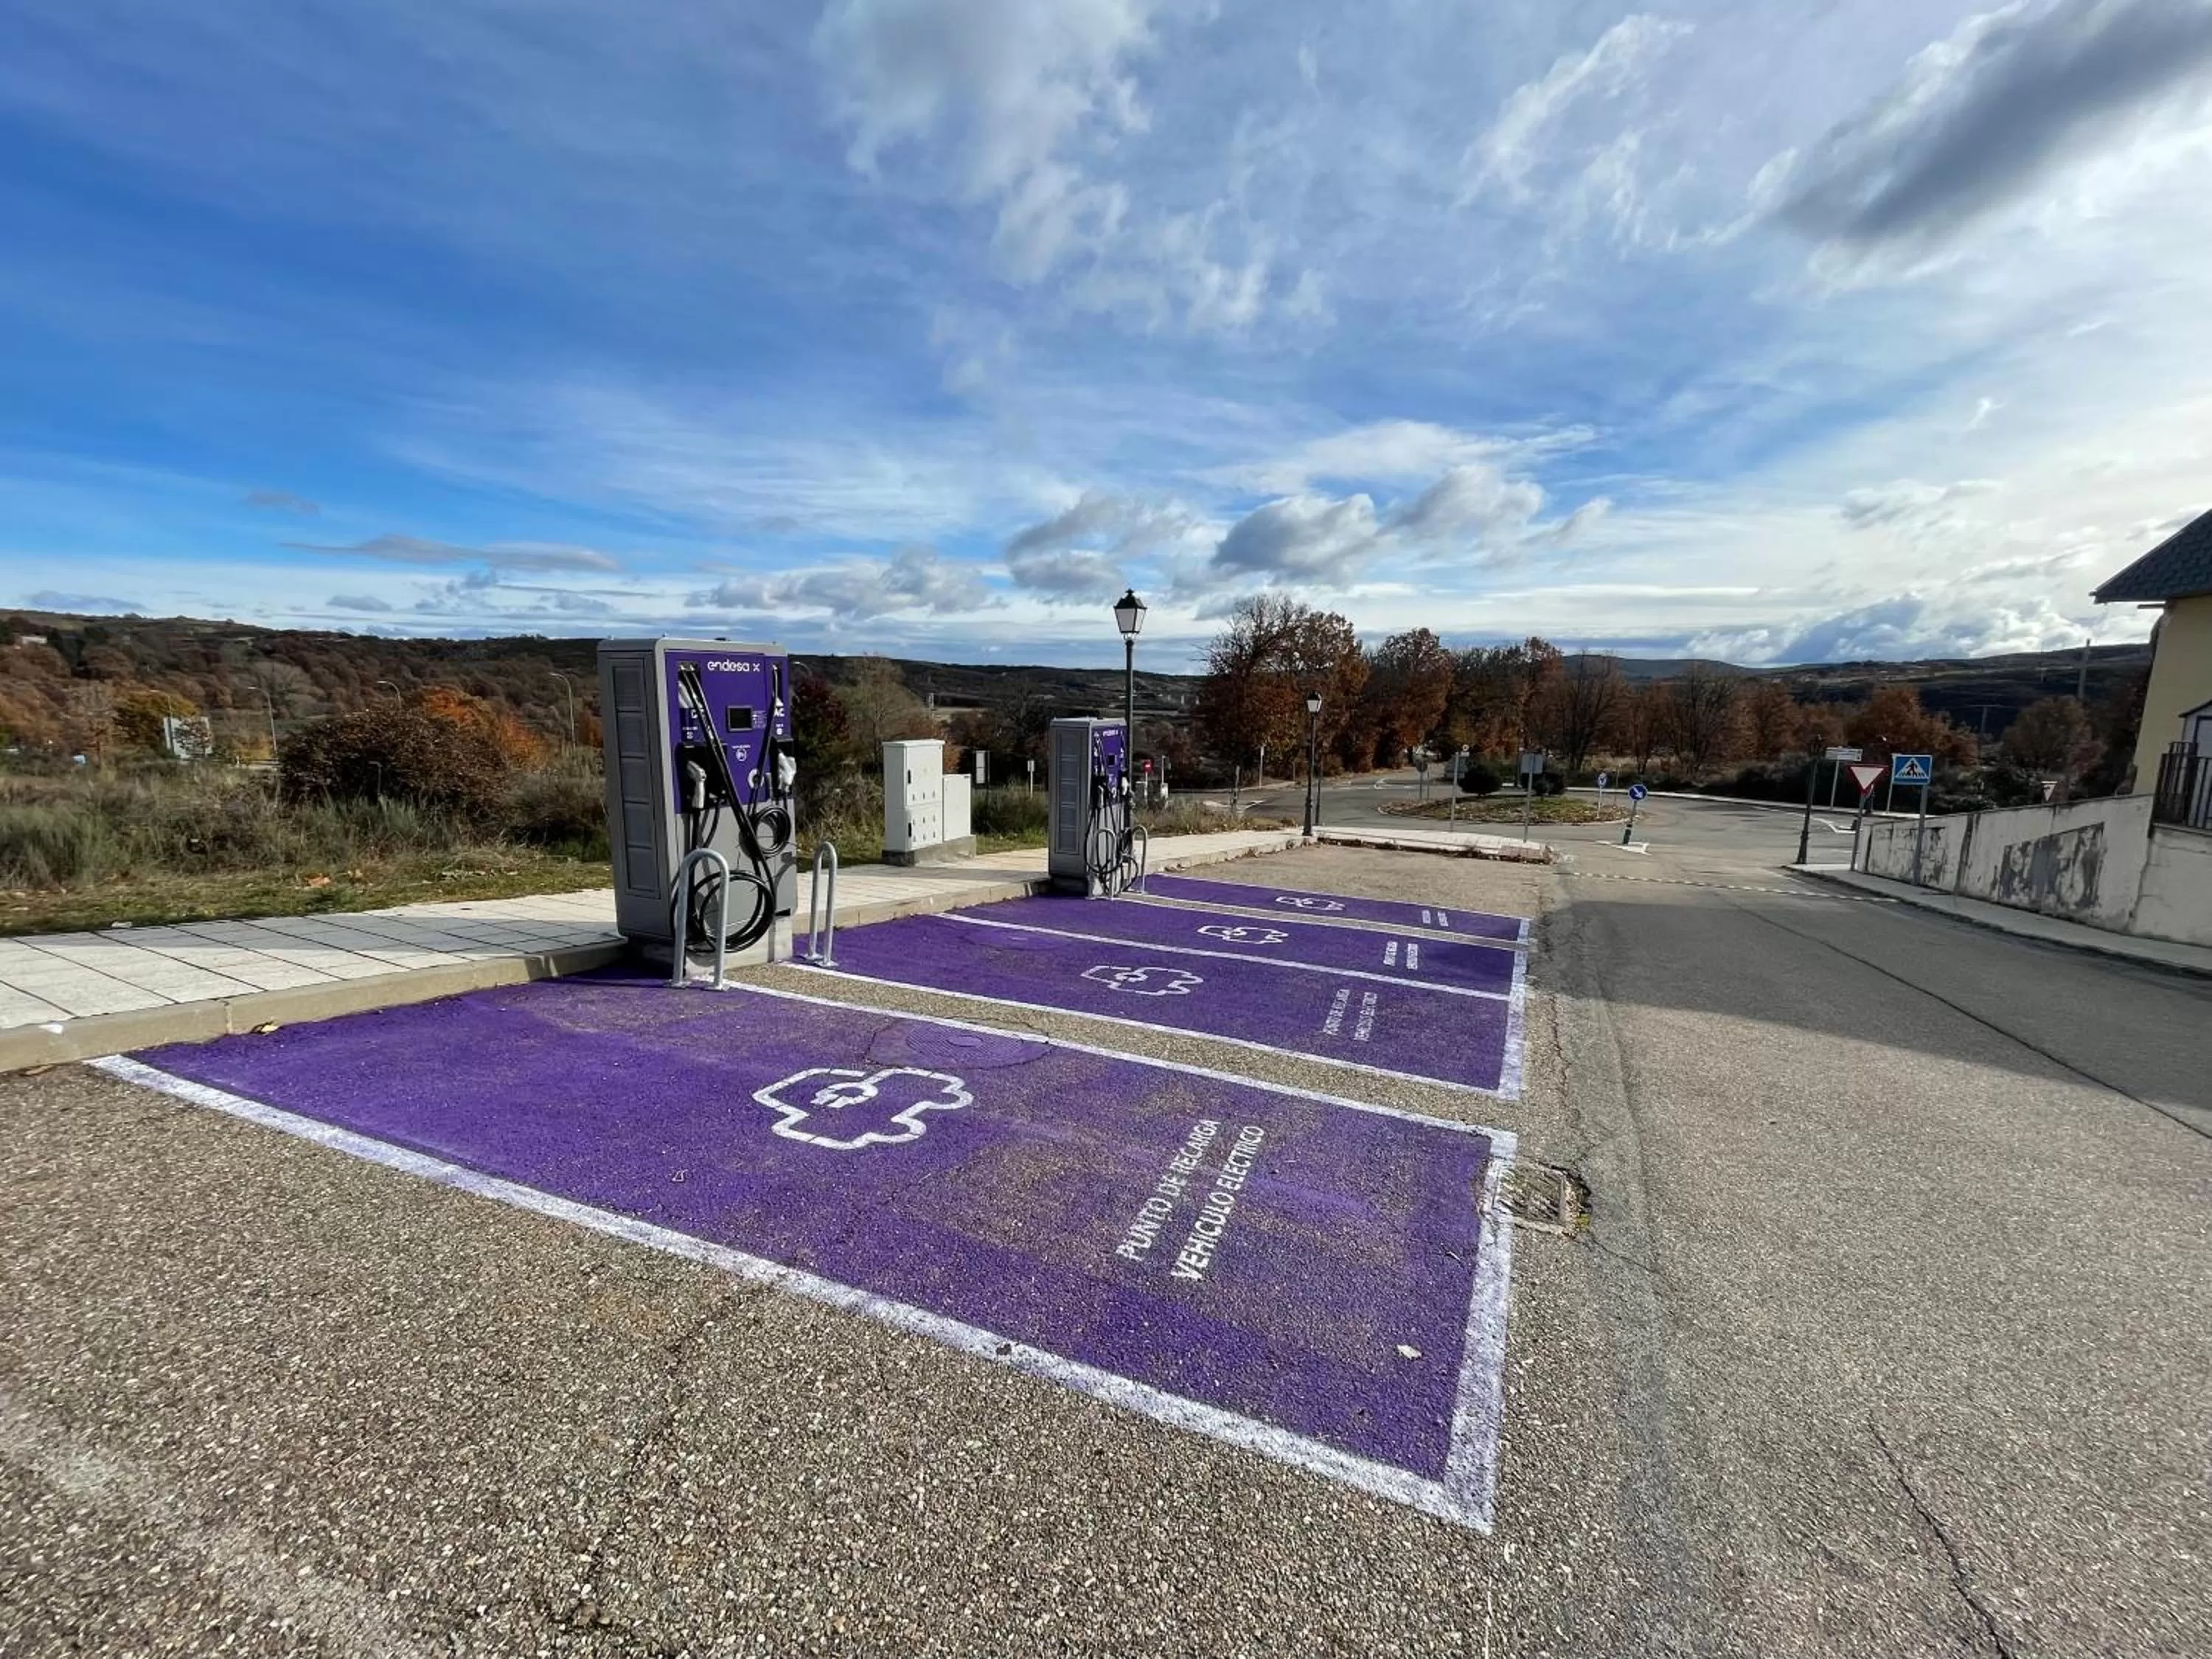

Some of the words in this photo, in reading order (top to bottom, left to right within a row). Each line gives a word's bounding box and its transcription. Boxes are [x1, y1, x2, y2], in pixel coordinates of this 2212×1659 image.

[707, 658, 750, 672] endesa
[752, 663, 760, 672] x
[1169, 1119, 1220, 1175] RECARGA
[1157, 1175, 1186, 1197] DE
[1171, 1192, 1235, 1280] VEHICULO
[1217, 1126, 1265, 1191] ELECTRICO
[1116, 1197, 1172, 1262] PUNTO
